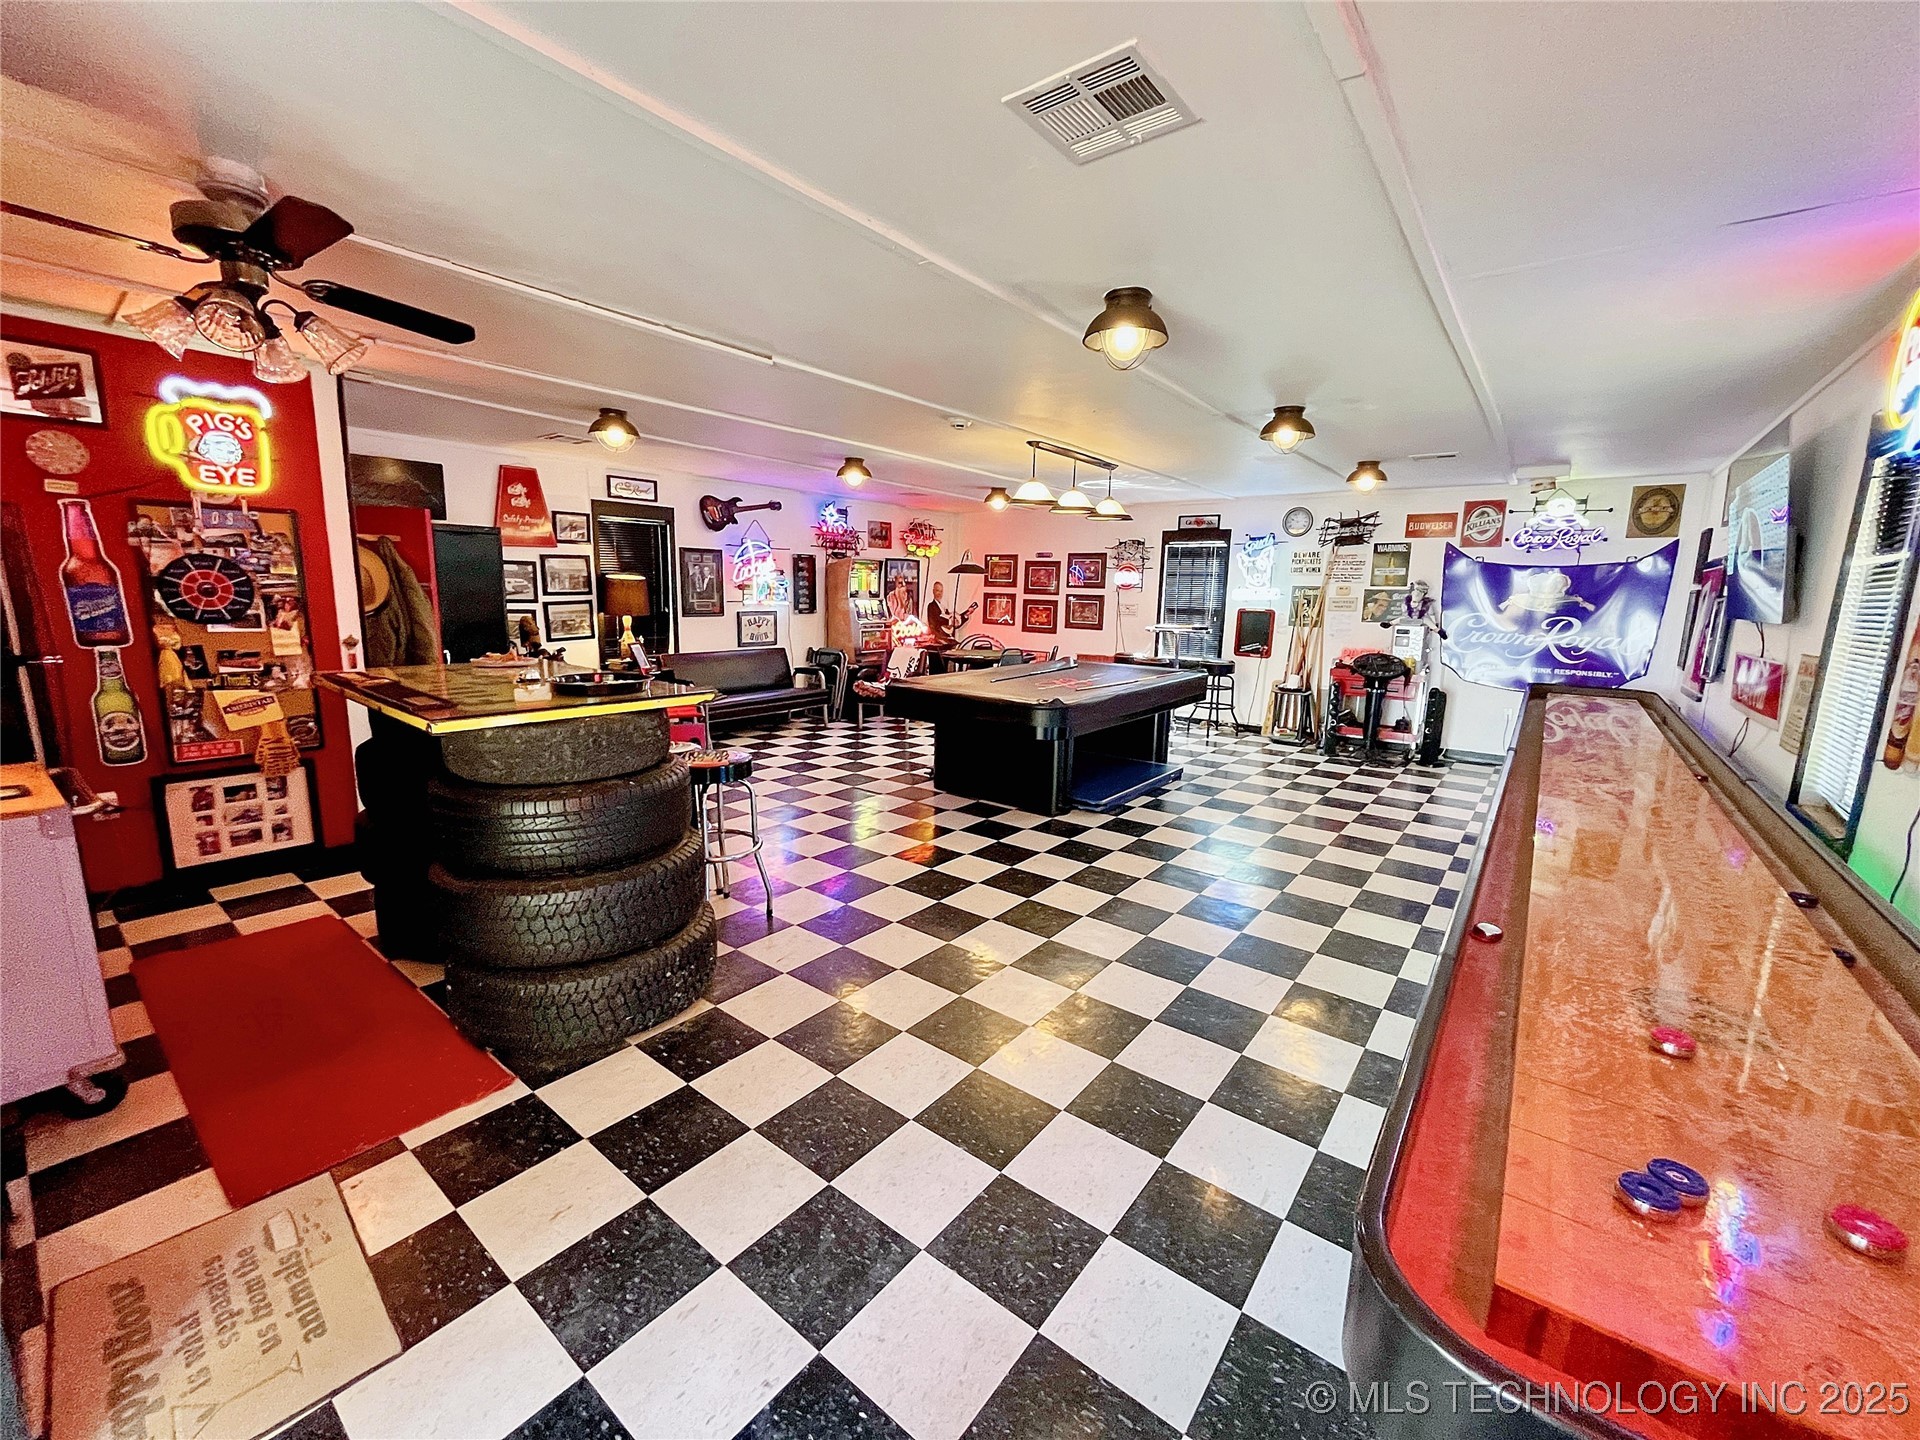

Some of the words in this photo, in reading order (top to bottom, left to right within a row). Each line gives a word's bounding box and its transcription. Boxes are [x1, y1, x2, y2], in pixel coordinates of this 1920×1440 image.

[186, 412, 253, 440] PIG'S
[199, 465, 256, 487] EYE
[1408, 521, 1453, 531] BUDWEISER
[1511, 527, 1553, 550] Crown
[1541, 527, 1604, 551] Royal
[1242, 533, 1274, 556] Spuds
[747, 616, 770, 627] HAPPY
[750, 631, 769, 641] HOUR
[1446, 613, 1543, 654] Crown
[226, 696, 274, 712] AMERISTAR
[232, 1245, 260, 1279] the
[200, 1253, 245, 1350] separates
[244, 1273, 275, 1326] from
[271, 1249, 329, 1345] animals
[101, 1276, 153, 1366] Hour
[170, 1310, 206, 1370] what
[256, 1322, 284, 1356] us
[178, 1366, 213, 1400] is
